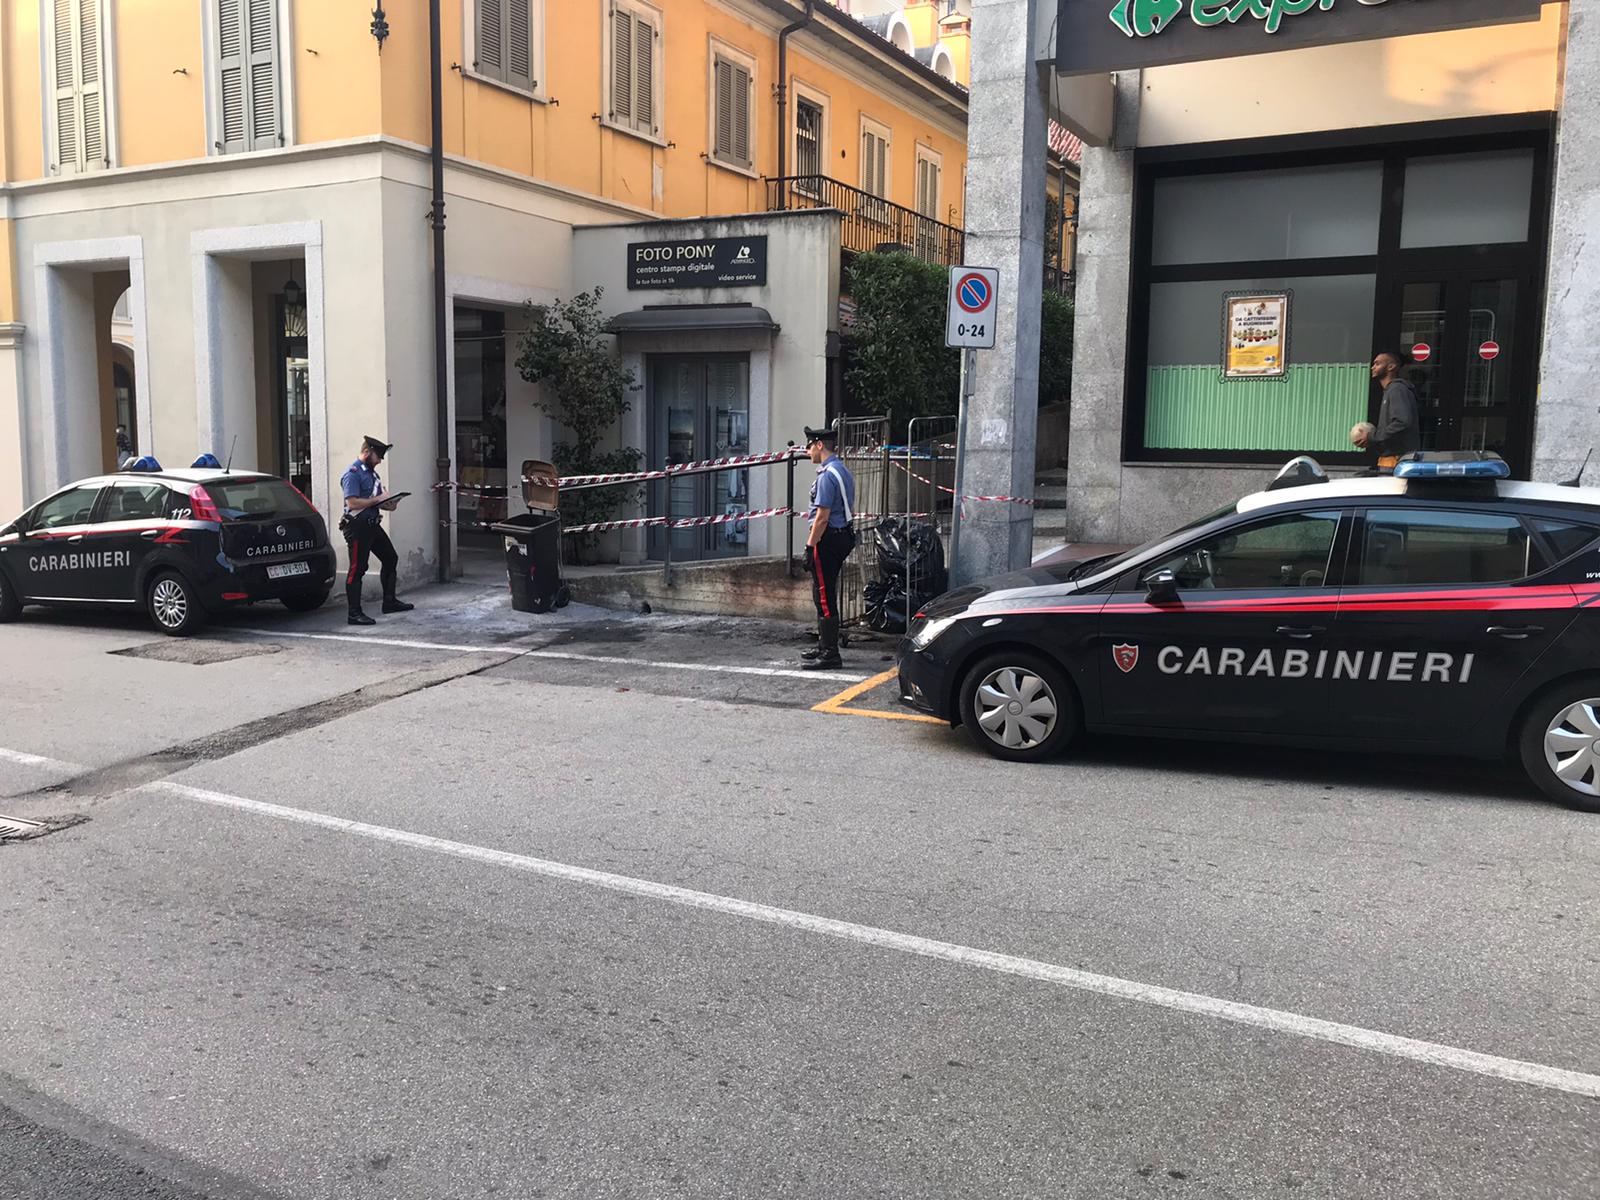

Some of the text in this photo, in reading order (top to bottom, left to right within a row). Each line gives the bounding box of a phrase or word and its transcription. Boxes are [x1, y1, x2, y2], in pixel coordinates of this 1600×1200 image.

[636, 245, 715, 261] FOTO PONY
[636, 262, 715, 274] centro stampa digitale
[736, 273, 756, 281] service
[958, 323, 985, 338] 0-24
[171, 508, 192, 520] 112
[246, 540, 314, 557] CARABINIERI
[29, 550, 130, 572] CARABINIERI
[1157, 645, 1475, 683] CARABINIERI
